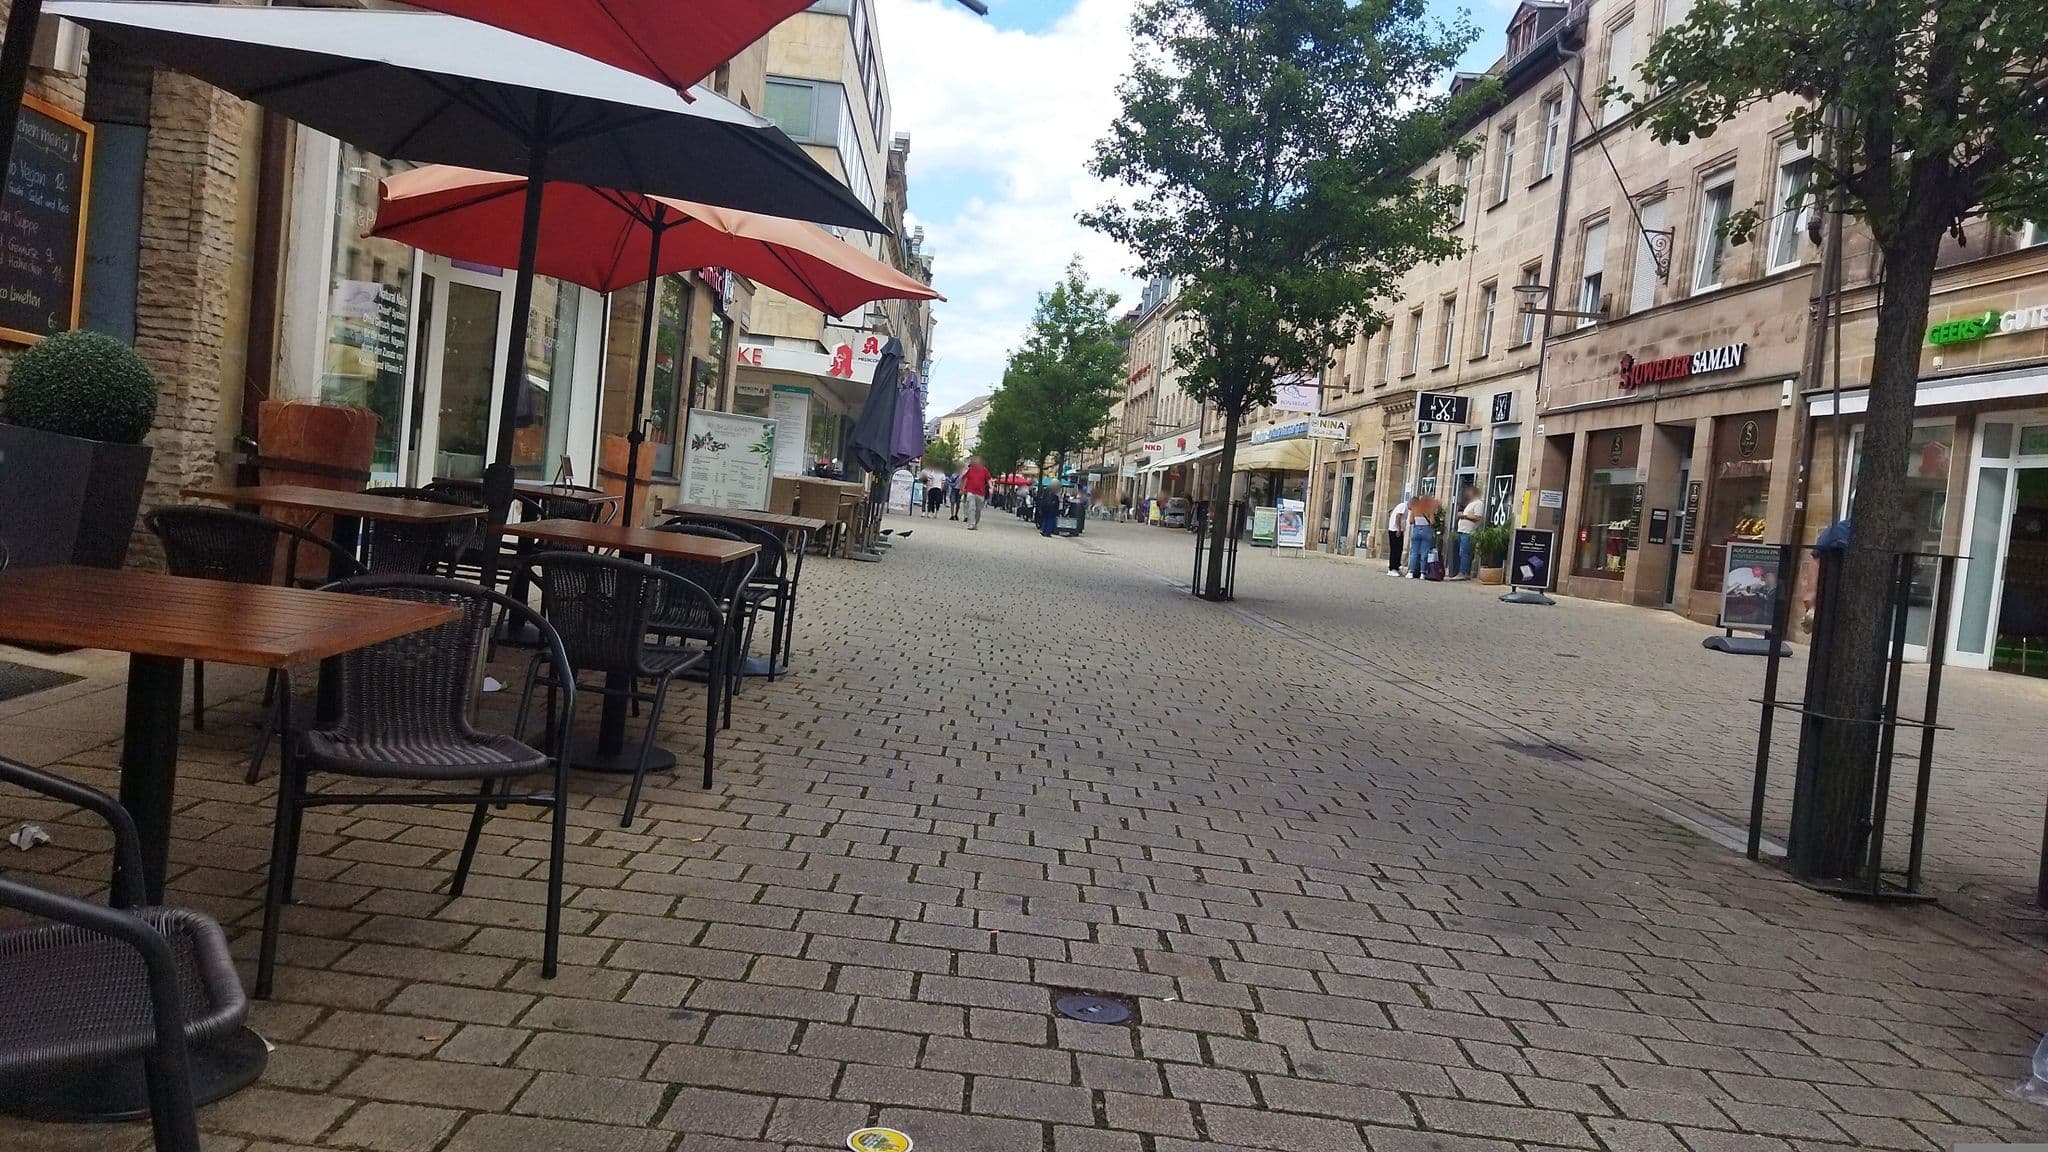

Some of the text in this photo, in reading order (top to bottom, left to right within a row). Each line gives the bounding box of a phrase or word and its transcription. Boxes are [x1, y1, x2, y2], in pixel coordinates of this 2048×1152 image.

[1928, 318, 1984, 346] GEERS
[737, 346, 763, 366] KE
[1691, 342, 1746, 376] SAMAN
[1319, 420, 1345, 430] NINA
